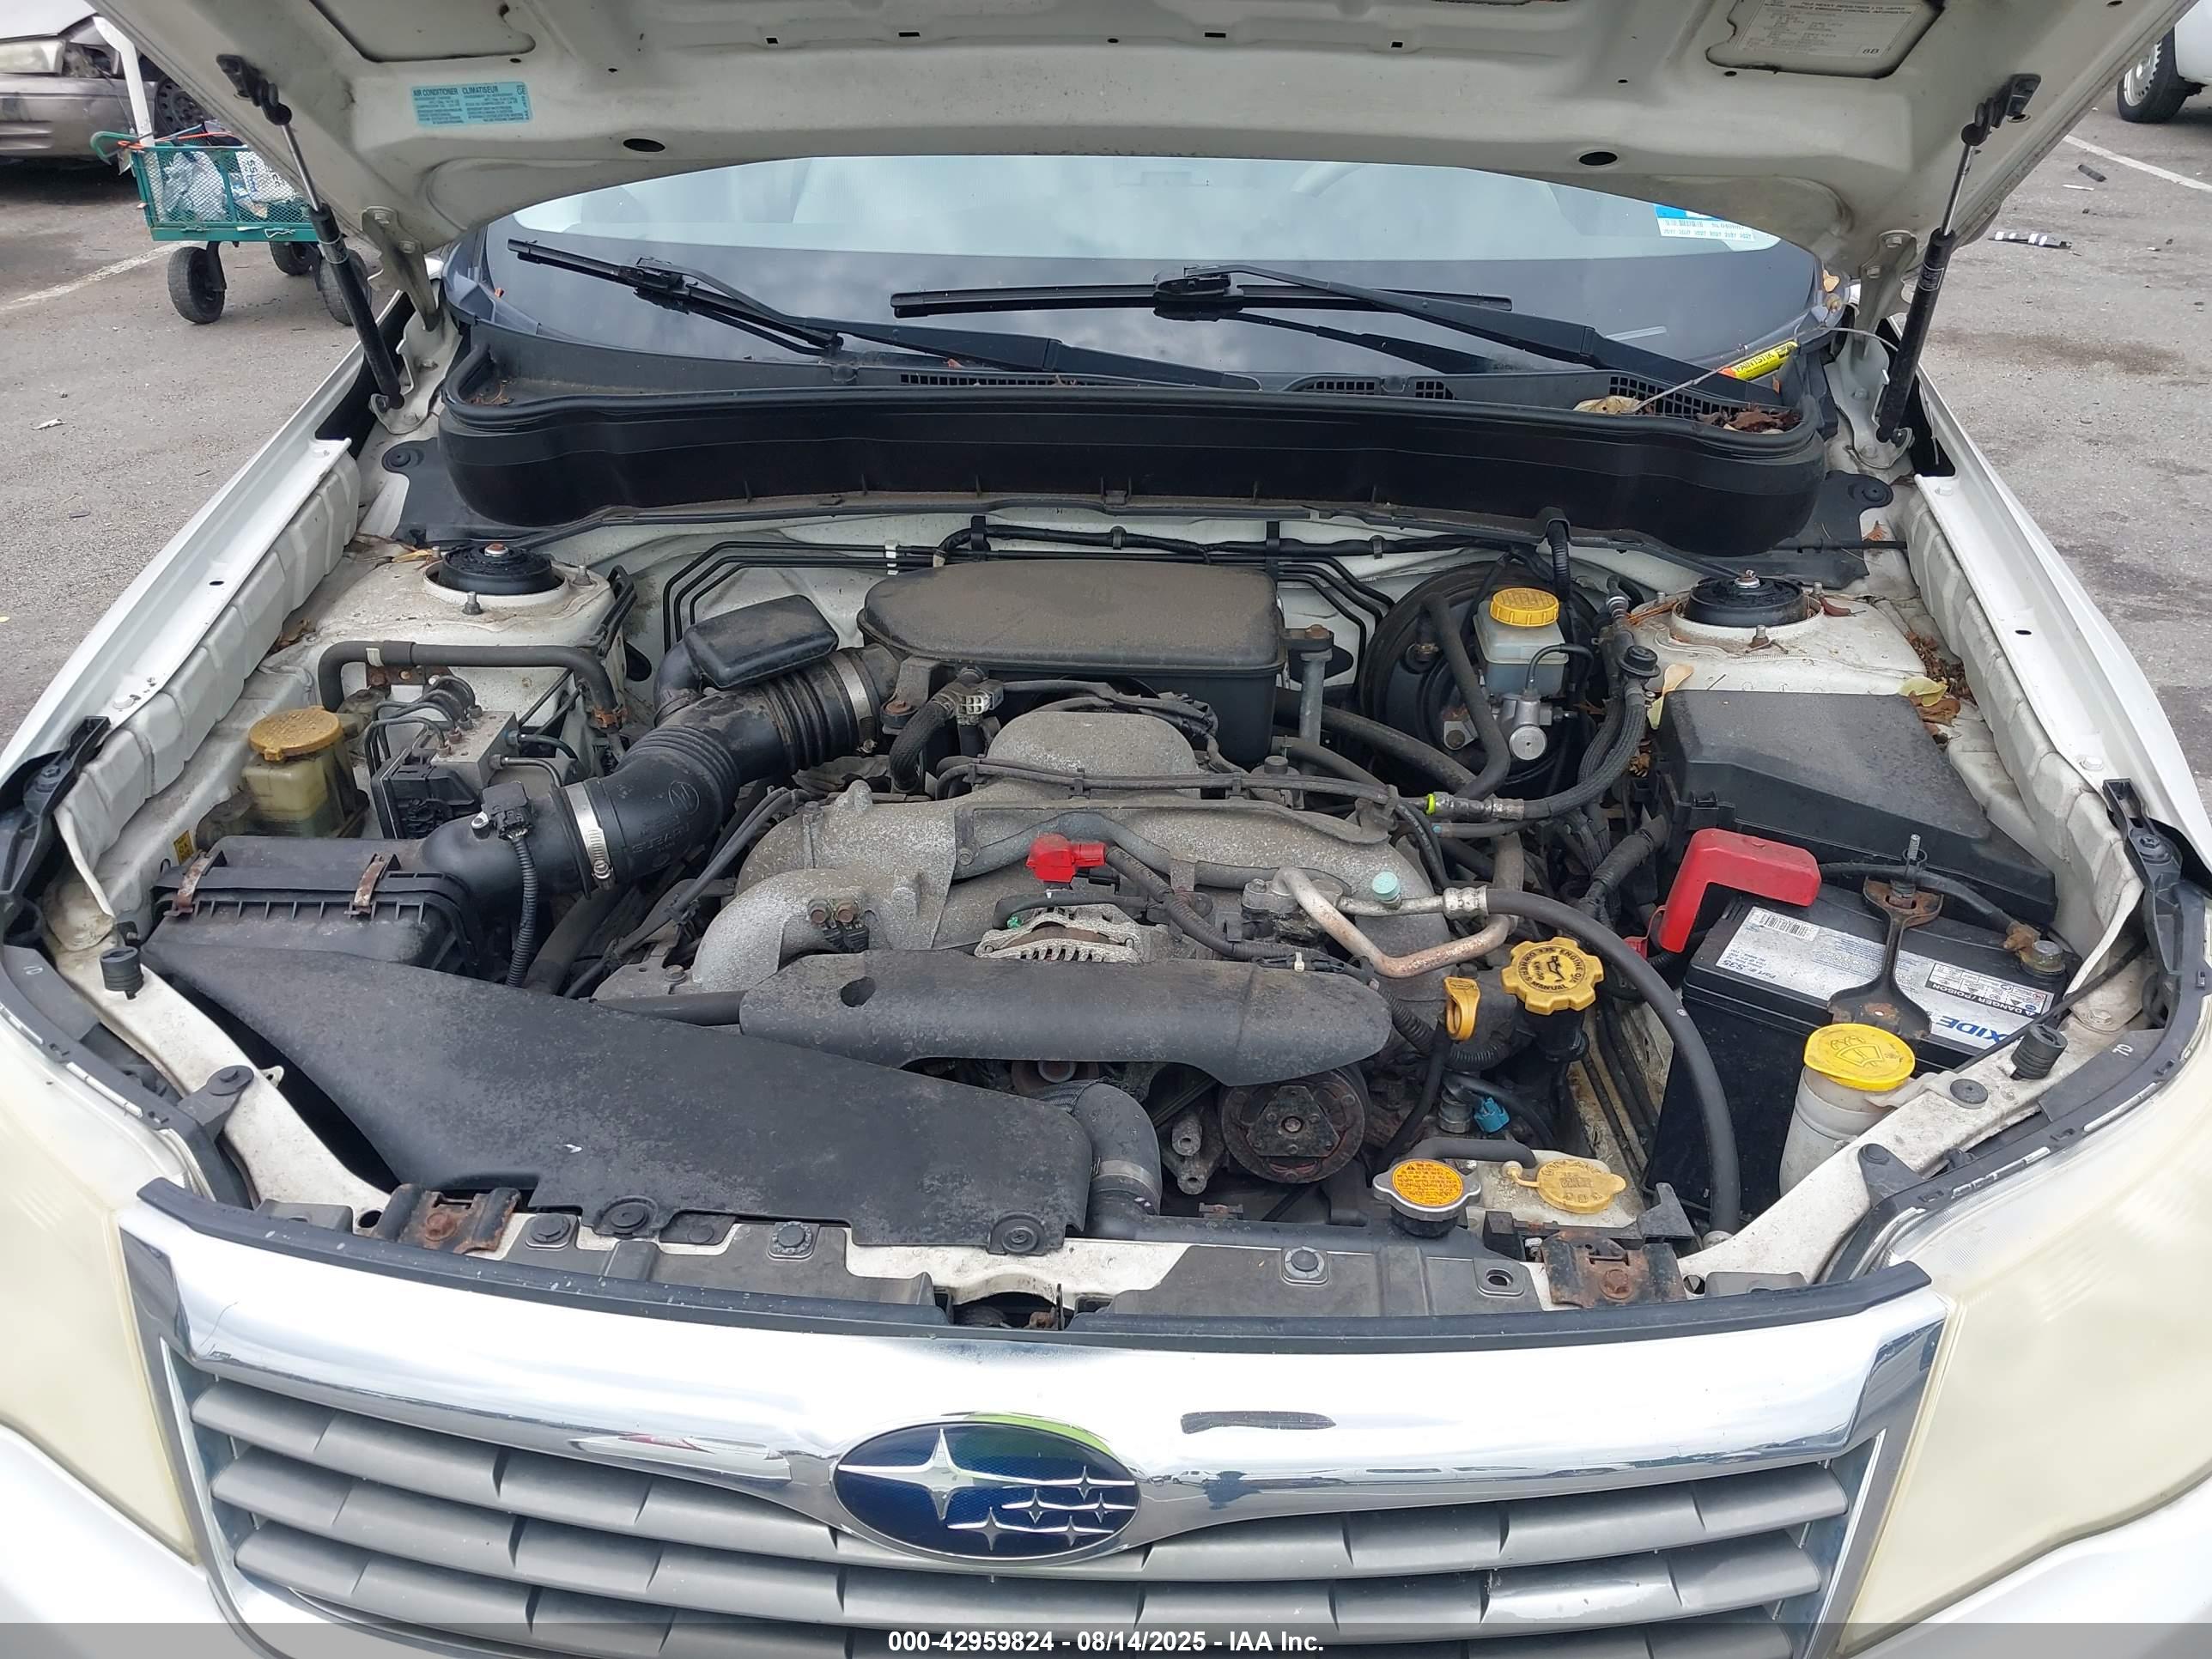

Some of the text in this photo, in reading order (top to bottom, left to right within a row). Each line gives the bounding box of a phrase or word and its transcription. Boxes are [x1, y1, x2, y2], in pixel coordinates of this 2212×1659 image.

[422, 88, 458, 96] CONDITIONER
[1531, 981, 1569, 991] MANUAL
[1977, 997, 2023, 1014] DANGER
[1936, 1015, 2010, 1044] XIDE
